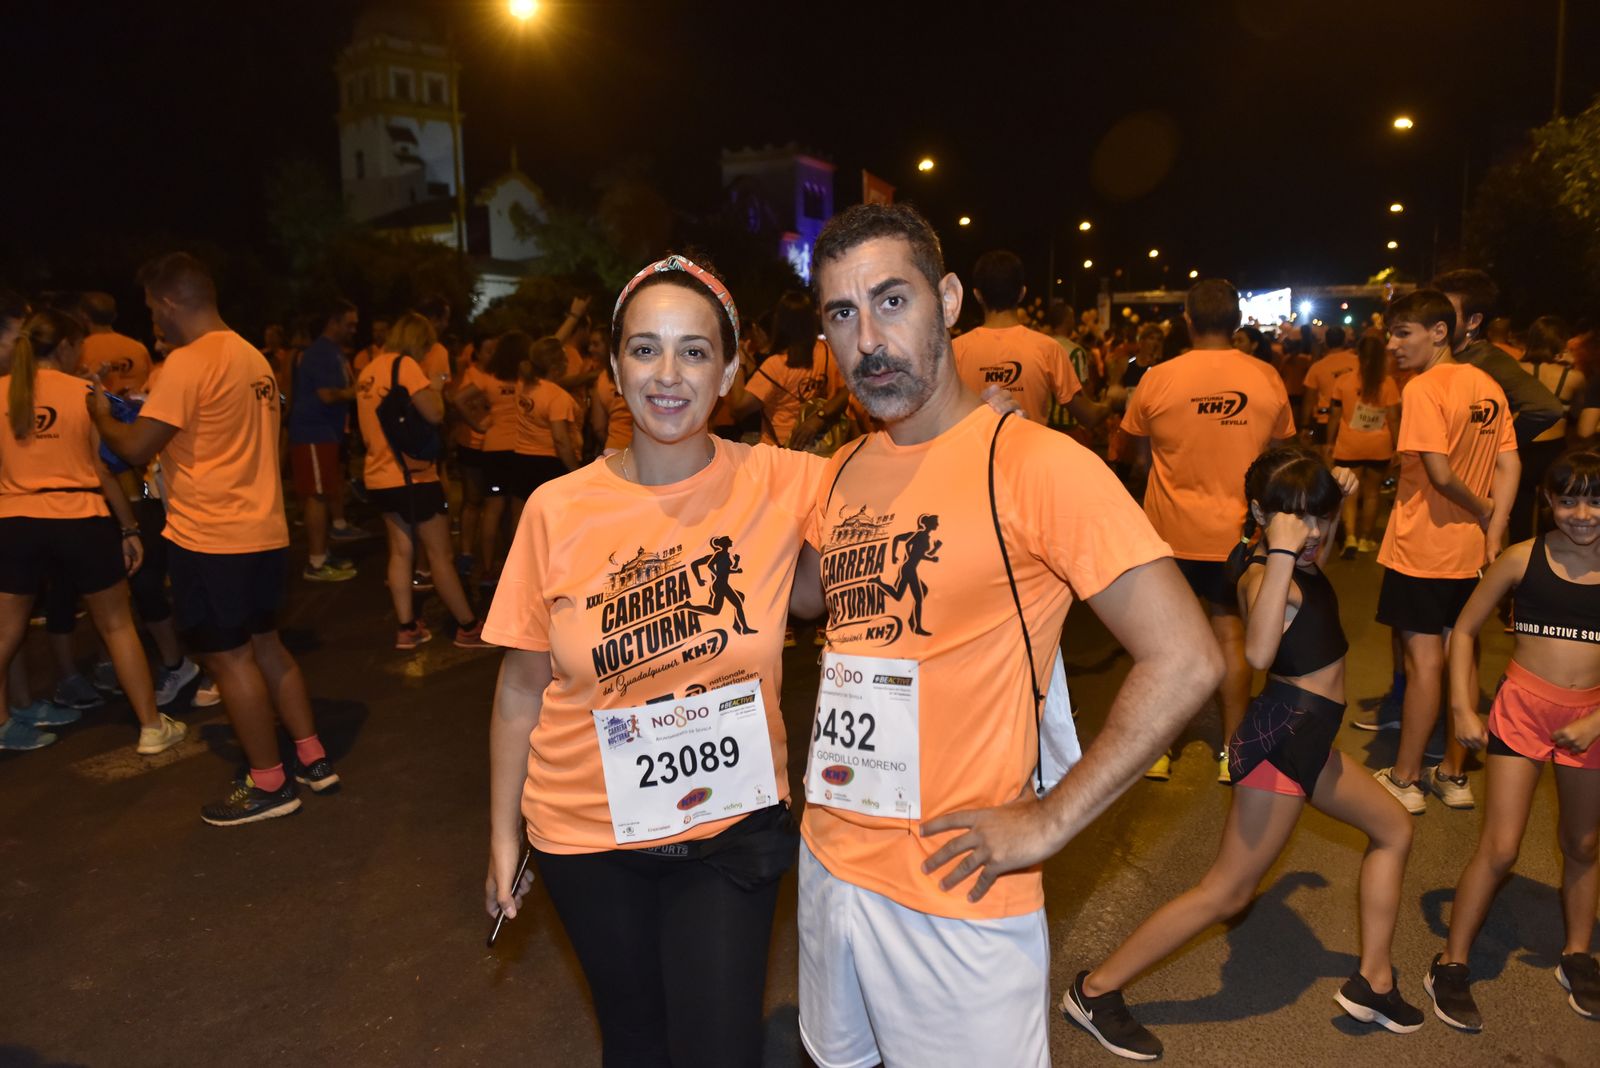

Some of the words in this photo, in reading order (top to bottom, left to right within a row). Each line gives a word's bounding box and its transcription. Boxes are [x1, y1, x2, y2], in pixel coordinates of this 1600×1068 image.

[822, 542, 888, 588] CARRERA
[585, 592, 605, 610] XXXI
[601, 570, 692, 634] CARRERA
[592, 610, 702, 678] NOCTURNA
[1515, 621, 1540, 634] SQUAD
[1542, 625, 1578, 639] ACTIVE
[602, 684, 614, 697] del
[615, 658, 680, 698] Guadalquivir
[709, 669, 746, 686] nationale
[636, 736, 740, 788] 23089
[816, 750, 860, 766] GORDILLO
[861, 757, 907, 772] MORENO
